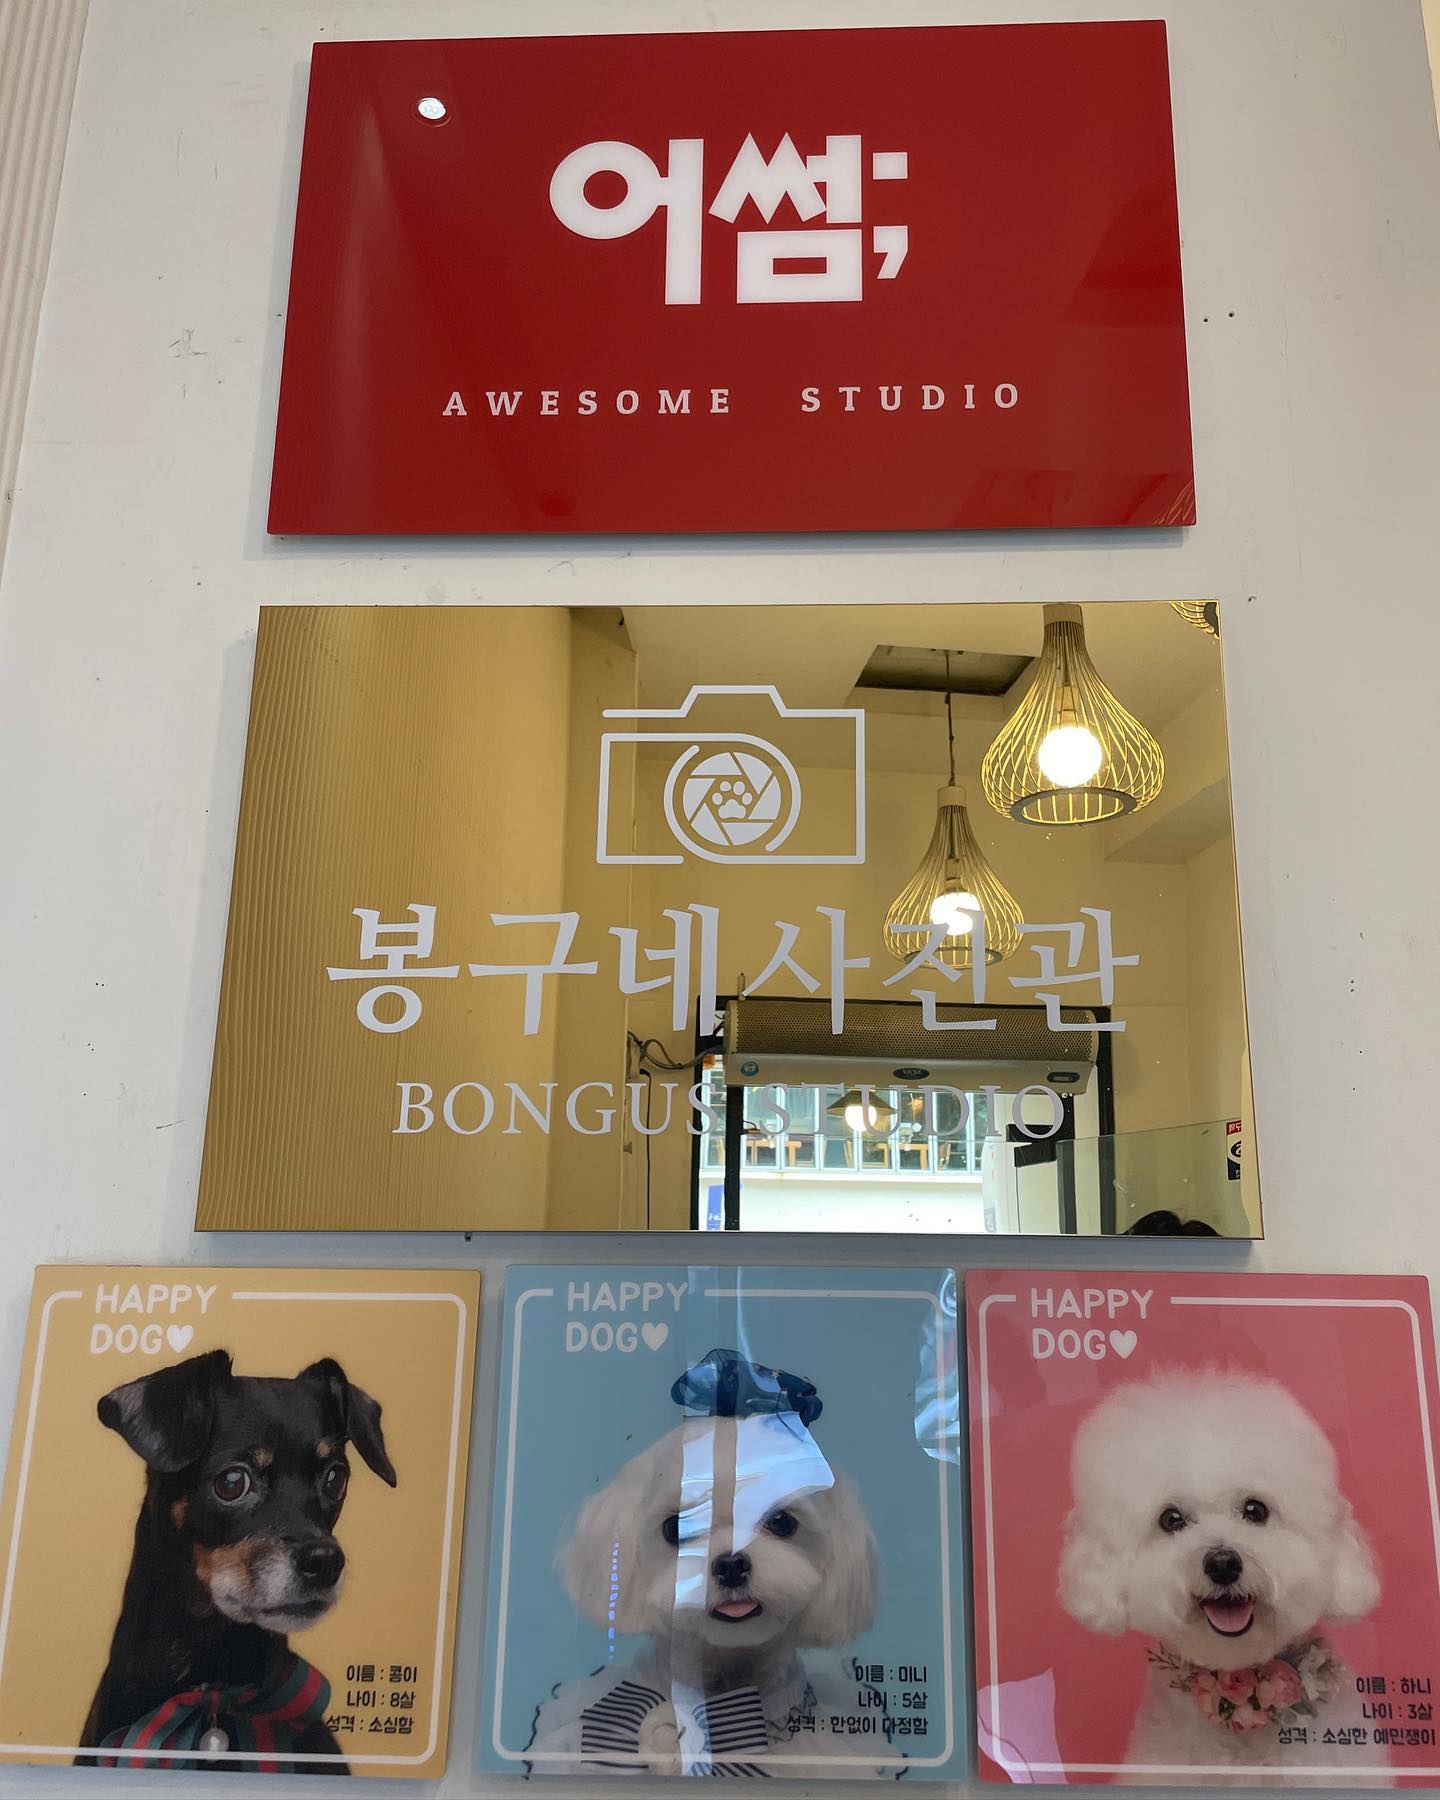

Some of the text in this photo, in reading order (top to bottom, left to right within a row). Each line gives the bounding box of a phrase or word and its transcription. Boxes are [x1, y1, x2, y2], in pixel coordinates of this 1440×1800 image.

[442, 382, 1021, 417] AWESOME STUDIO
[326, 903, 1140, 1037] 봉구네사진관
[392, 1081, 1065, 1139] BONGUS STUDIO
[95, 1283, 217, 1314] HAPPY
[567, 1280, 689, 1312] HAPPY
[1030, 1287, 1154, 1319] HAPPY
[89, 1323, 164, 1355] DOG
[565, 1321, 639, 1353] DOG
[1032, 1327, 1107, 1361] DOG
[346, 1664, 375, 1682] 이름
[855, 1665, 884, 1683] 이름
[898, 1666, 927, 1683] 미니
[1356, 1677, 1386, 1695] 이름
[1400, 1677, 1431, 1694] 하니
[346, 1690, 376, 1708] 나이
[390, 1691, 417, 1709] 8살
[858, 1691, 887, 1710] 나이
[902, 1692, 928, 1709] 5살
[1362, 1703, 1393, 1720] 나이
[1407, 1703, 1433, 1721] 3살
[326, 1715, 355, 1733] 성격
[368, 1716, 414, 1735] 소심함
[787, 1715, 816, 1734] 성격
[830, 1716, 876, 1734] 한없이
[882, 1717, 928, 1735] 다정함
[1278, 1727, 1307, 1745] 성격
[1322, 1727, 1368, 1746] 소심한
